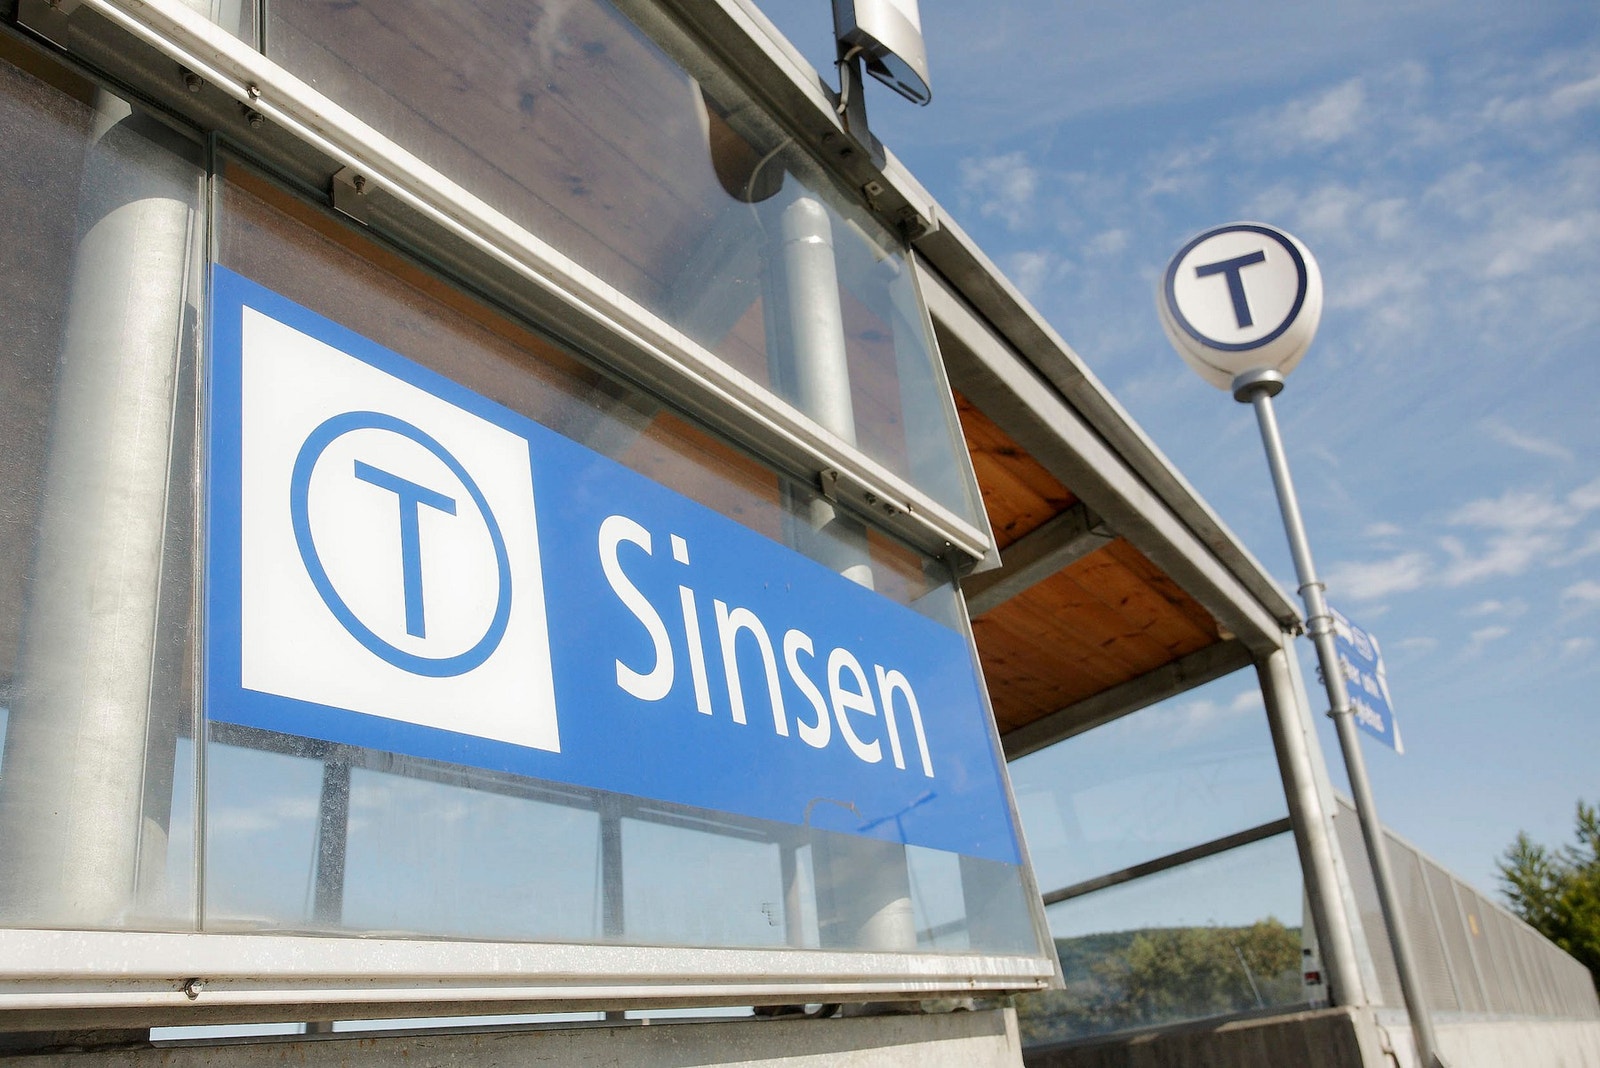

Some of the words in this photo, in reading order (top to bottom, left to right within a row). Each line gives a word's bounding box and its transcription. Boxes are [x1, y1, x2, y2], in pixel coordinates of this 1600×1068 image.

[1195, 250, 1266, 328] T
[354, 459, 457, 639] T
[598, 515, 935, 778] Sinsen
